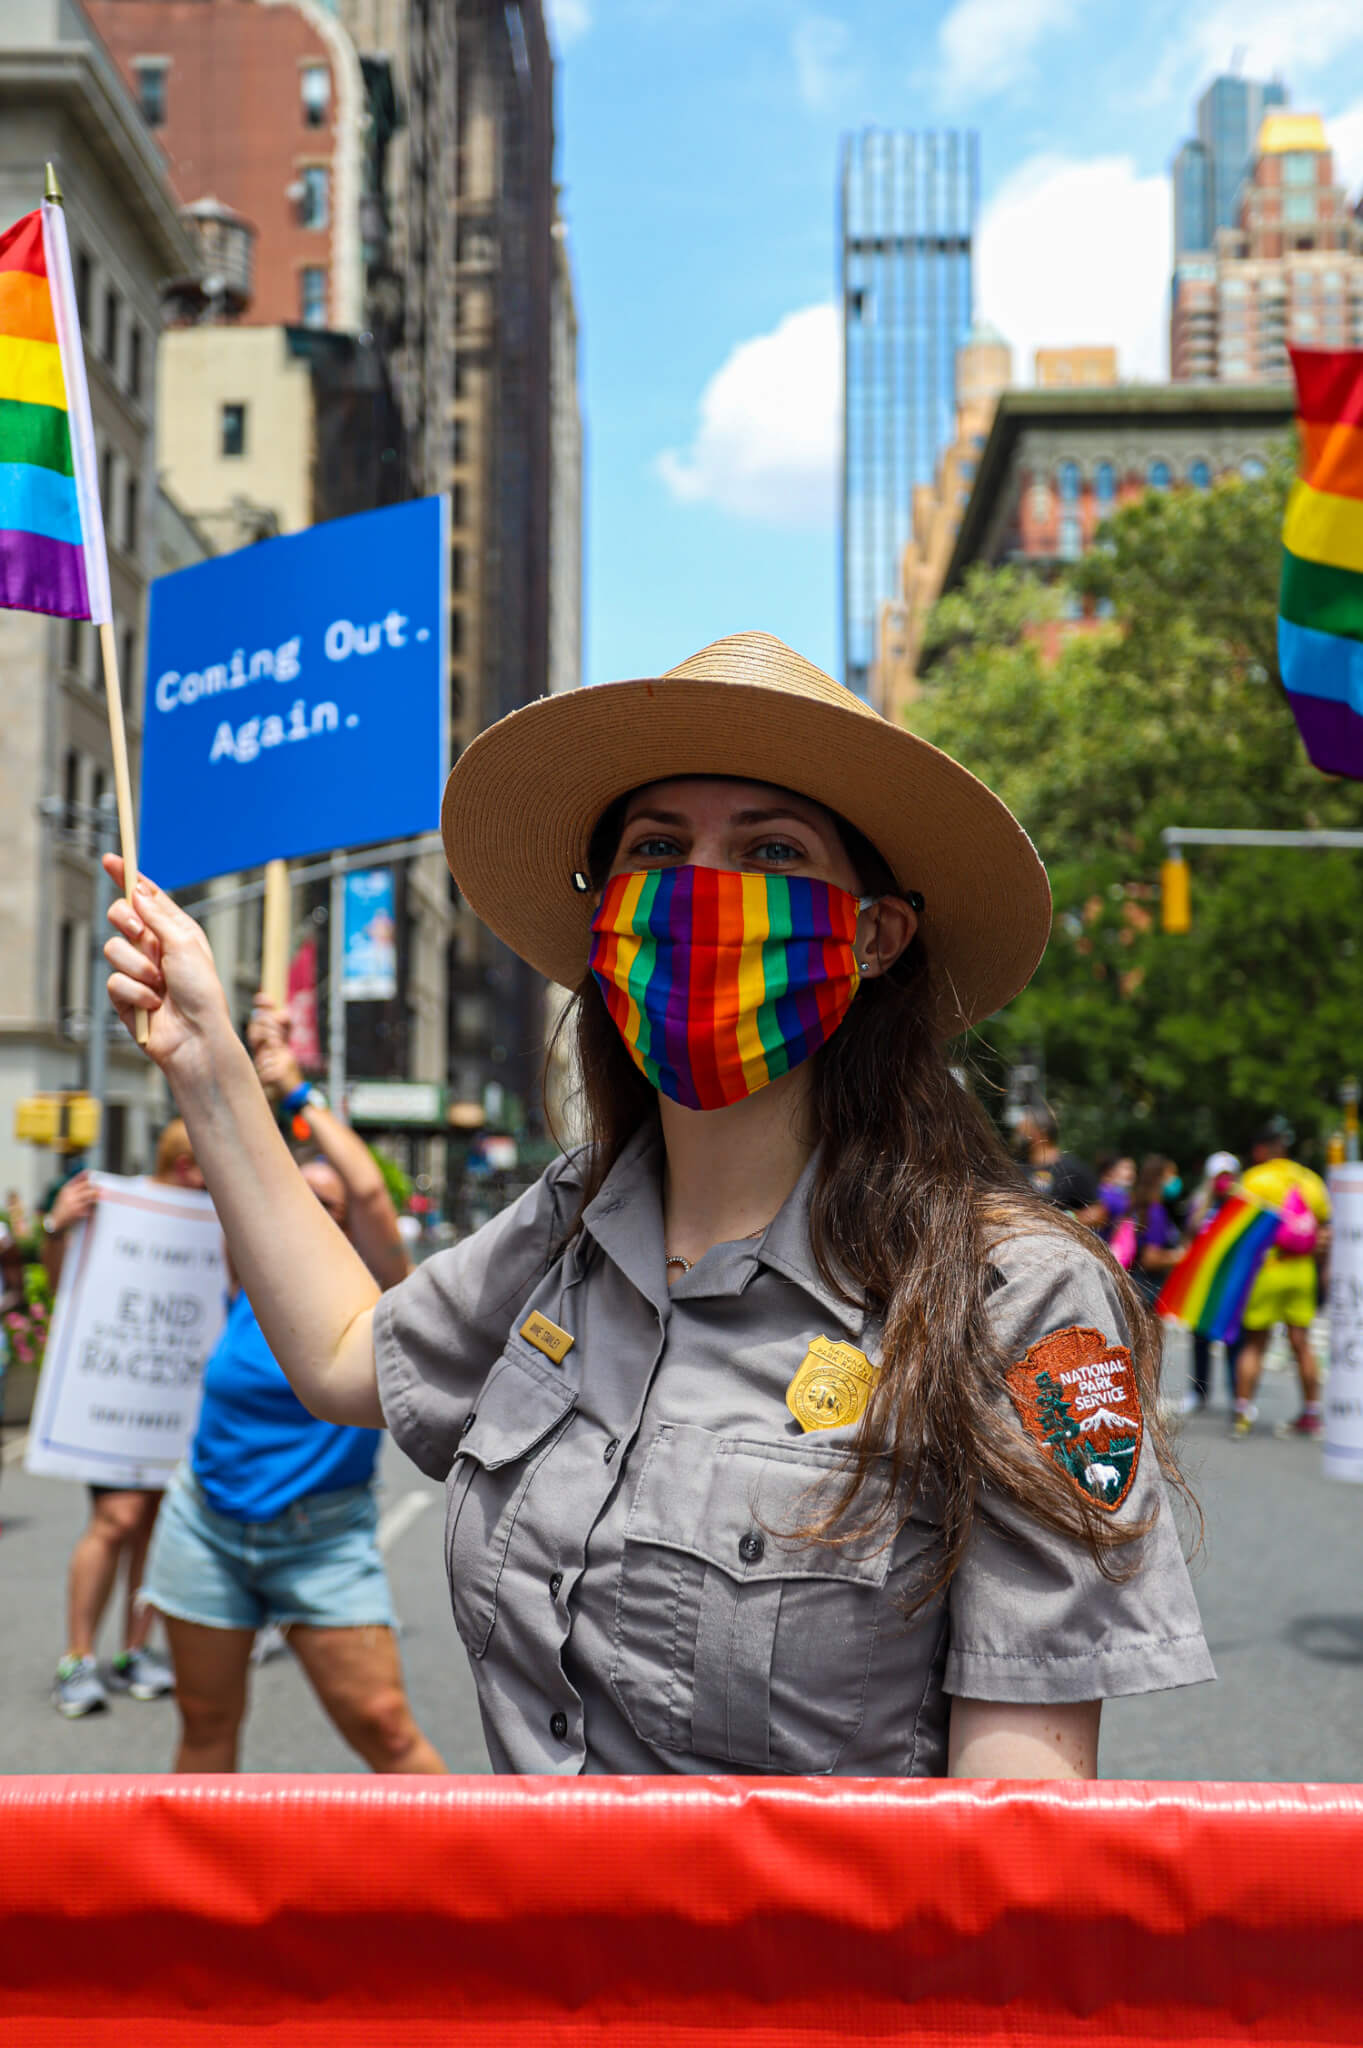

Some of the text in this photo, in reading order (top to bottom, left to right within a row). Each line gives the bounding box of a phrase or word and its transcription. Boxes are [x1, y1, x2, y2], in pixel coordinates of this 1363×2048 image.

[155, 610, 430, 712] Coming Out.
[209, 699, 359, 763] Again.
[117, 1286, 206, 1328] END
[1060, 1359, 1126, 1386] NATIONAL
[1078, 1376, 1113, 1395] PARK
[1075, 1386, 1127, 1411] SERVICE
